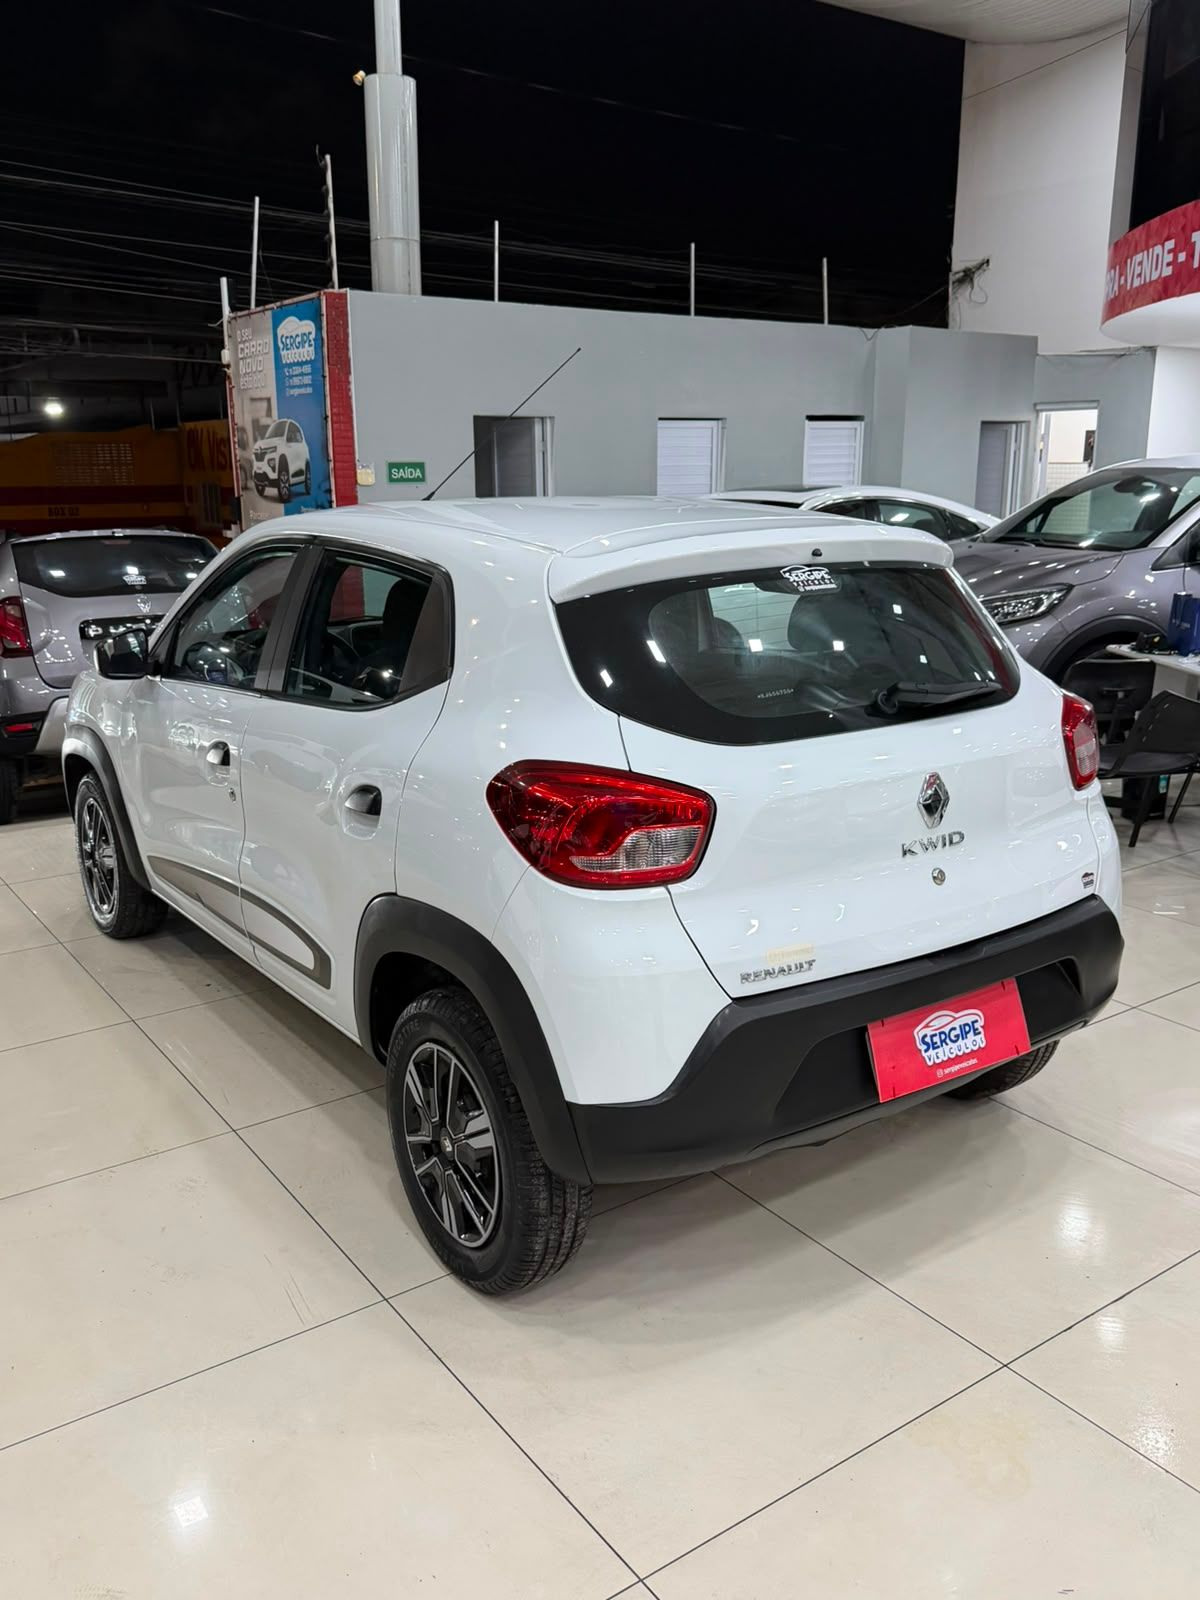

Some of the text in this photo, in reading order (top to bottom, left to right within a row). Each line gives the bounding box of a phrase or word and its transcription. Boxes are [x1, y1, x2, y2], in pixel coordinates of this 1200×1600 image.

[1126, 239, 1175, 291] VENDE
[238, 340, 269, 358] CARRO
[280, 331, 313, 352] SERGIPE
[239, 357, 264, 375] NOVO
[391, 466, 423, 480] SAÍDA
[784, 570, 831, 582] SERGIPE
[901, 831, 965, 858] KWID
[739, 958, 816, 984] RENAULT
[919, 1019, 982, 1053] SERGIPE
[926, 1037, 985, 1064] VEÍCULOS
